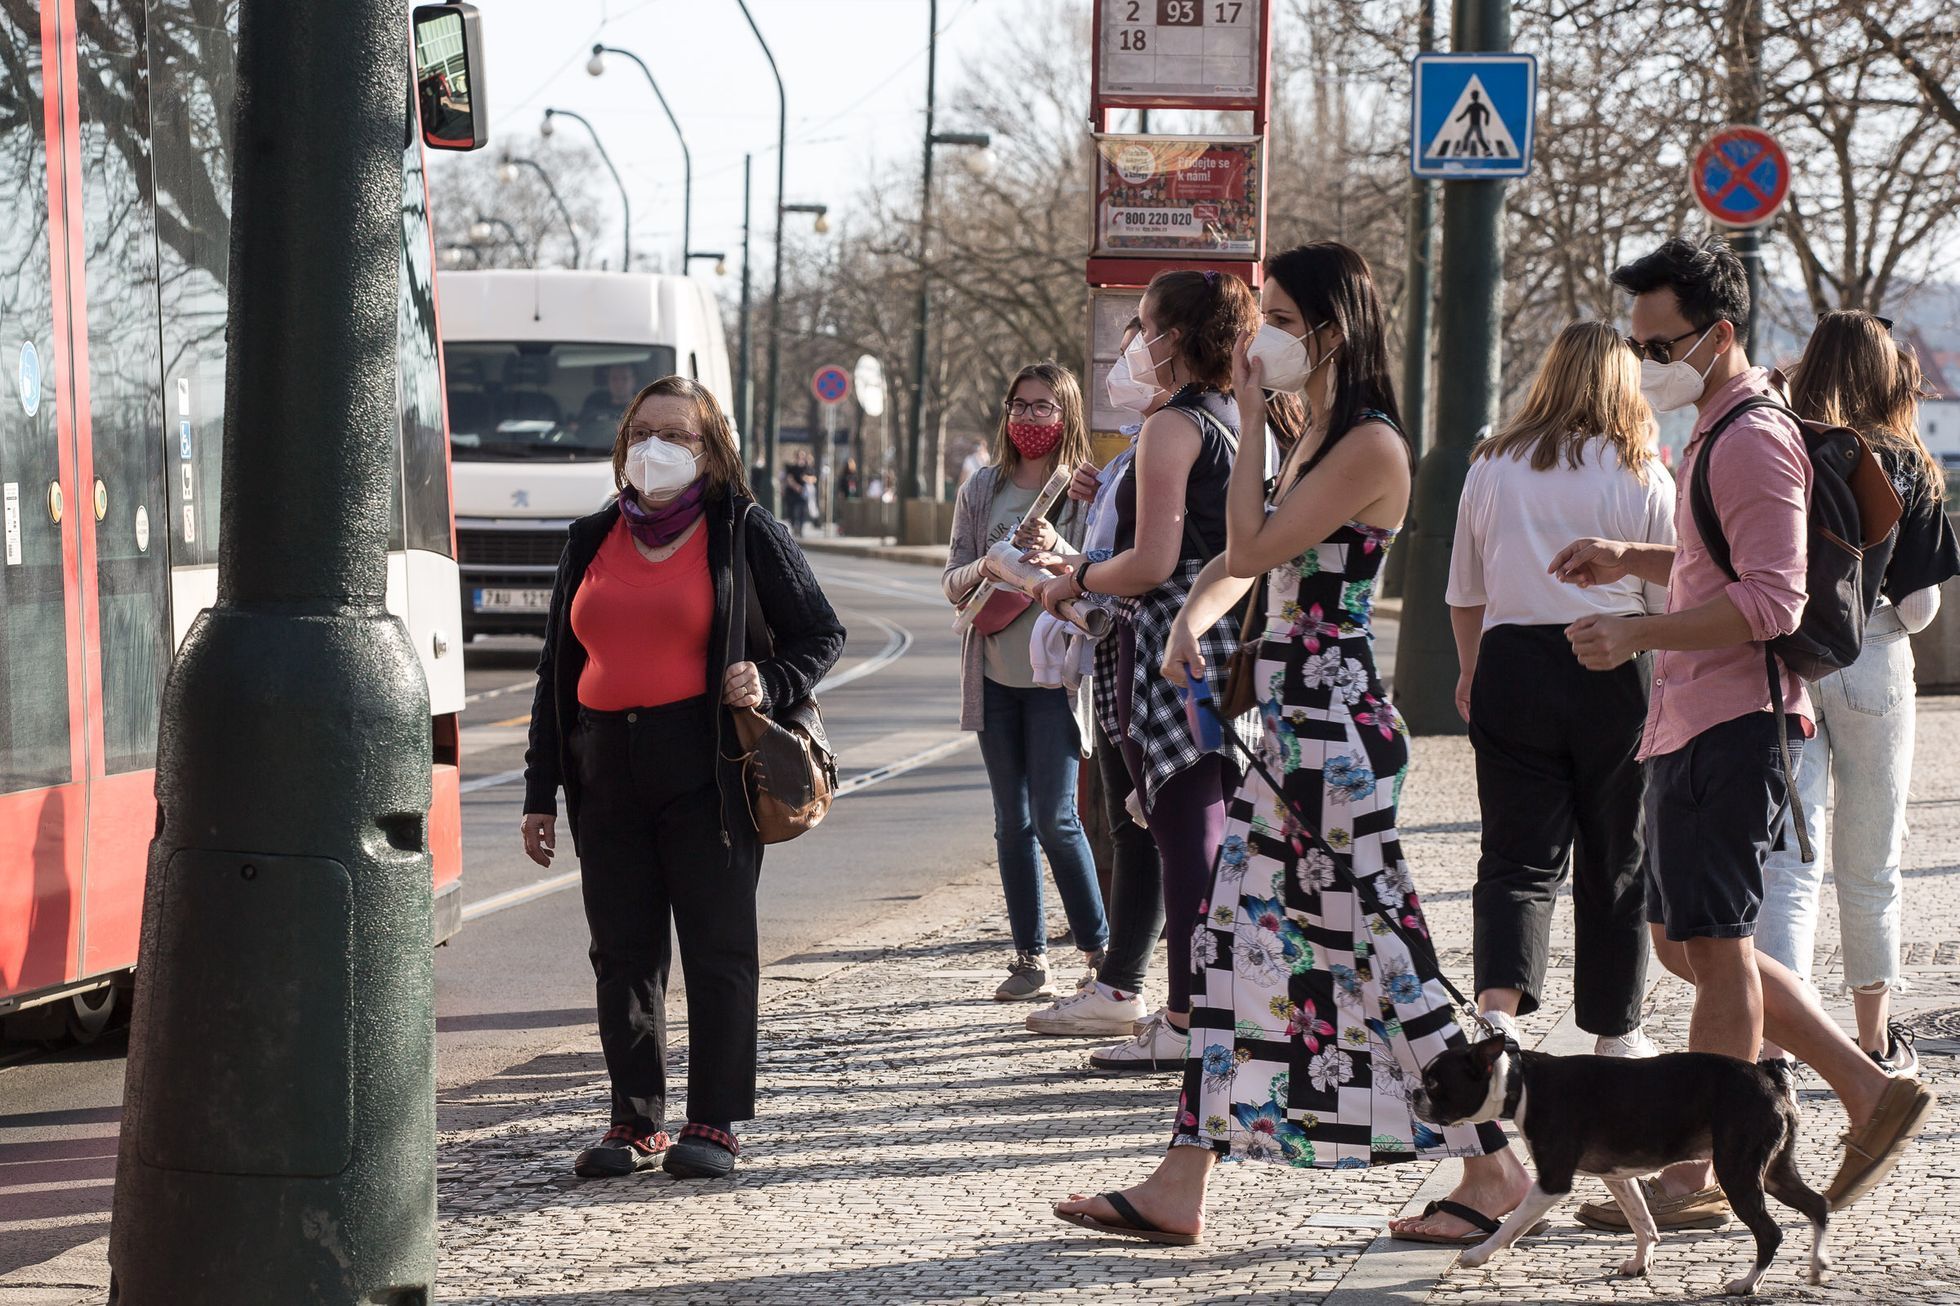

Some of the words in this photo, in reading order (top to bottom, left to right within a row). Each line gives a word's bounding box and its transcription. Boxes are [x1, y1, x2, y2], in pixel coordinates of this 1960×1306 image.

[1126, 0, 1140, 22] 2
[1167, 0, 1194, 23] 93
[1215, 2, 1242, 24] 17
[1119, 29, 1146, 51] 18
[1218, 160, 1230, 169] se
[1177, 170, 1185, 181] k
[1186, 170, 1211, 181] nám!
[1125, 212, 1146, 225] 800
[1148, 212, 1169, 225] 220
[1171, 213, 1192, 226] 020
